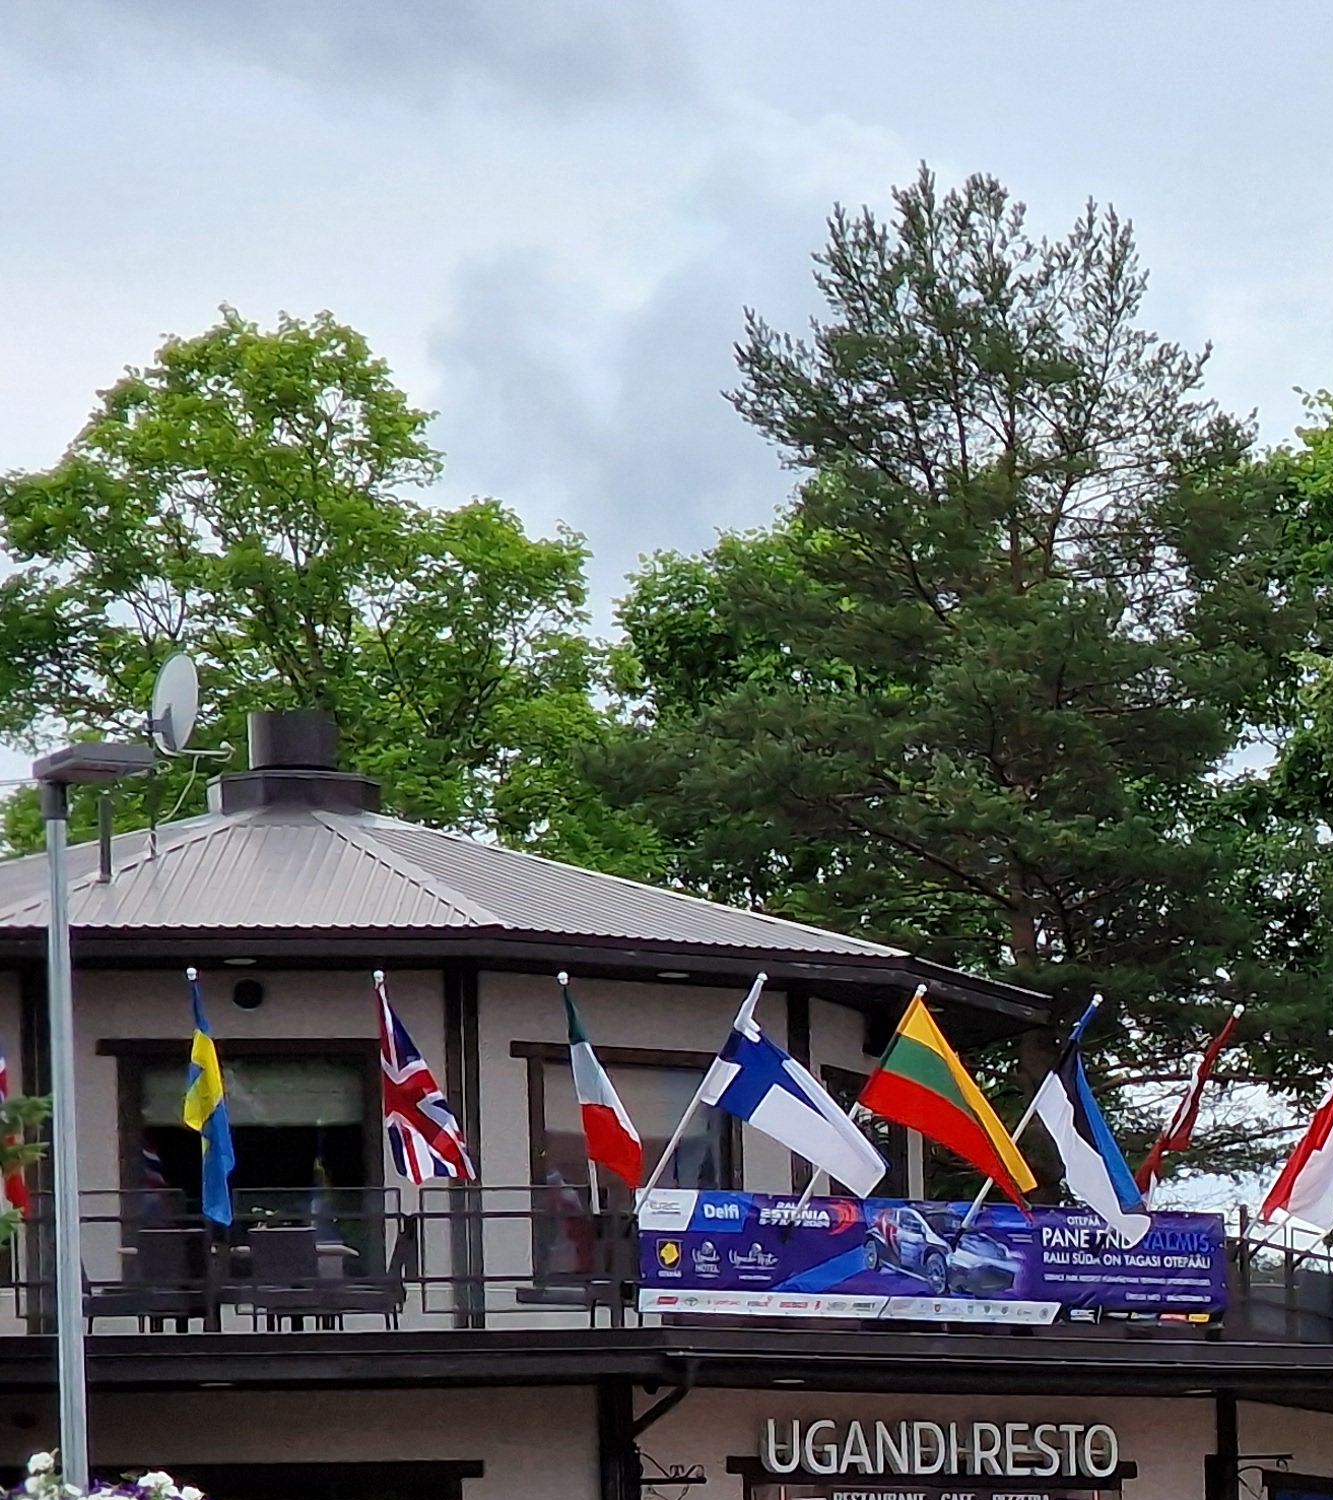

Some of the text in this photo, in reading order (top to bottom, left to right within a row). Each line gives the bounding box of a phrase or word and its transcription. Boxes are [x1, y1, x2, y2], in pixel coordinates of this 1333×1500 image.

[703, 1203, 740, 1219] Delfi
[1042, 1227, 1090, 1248] PANE
[1043, 1251, 1070, 1264] RALLI
[1103, 1254, 1122, 1266] ON
[1124, 1254, 1161, 1268] TAGASI
[1164, 1255, 1211, 1269] OTEPÄÄLI
[766, 1418, 1119, 1477] UGANDI RESTO
